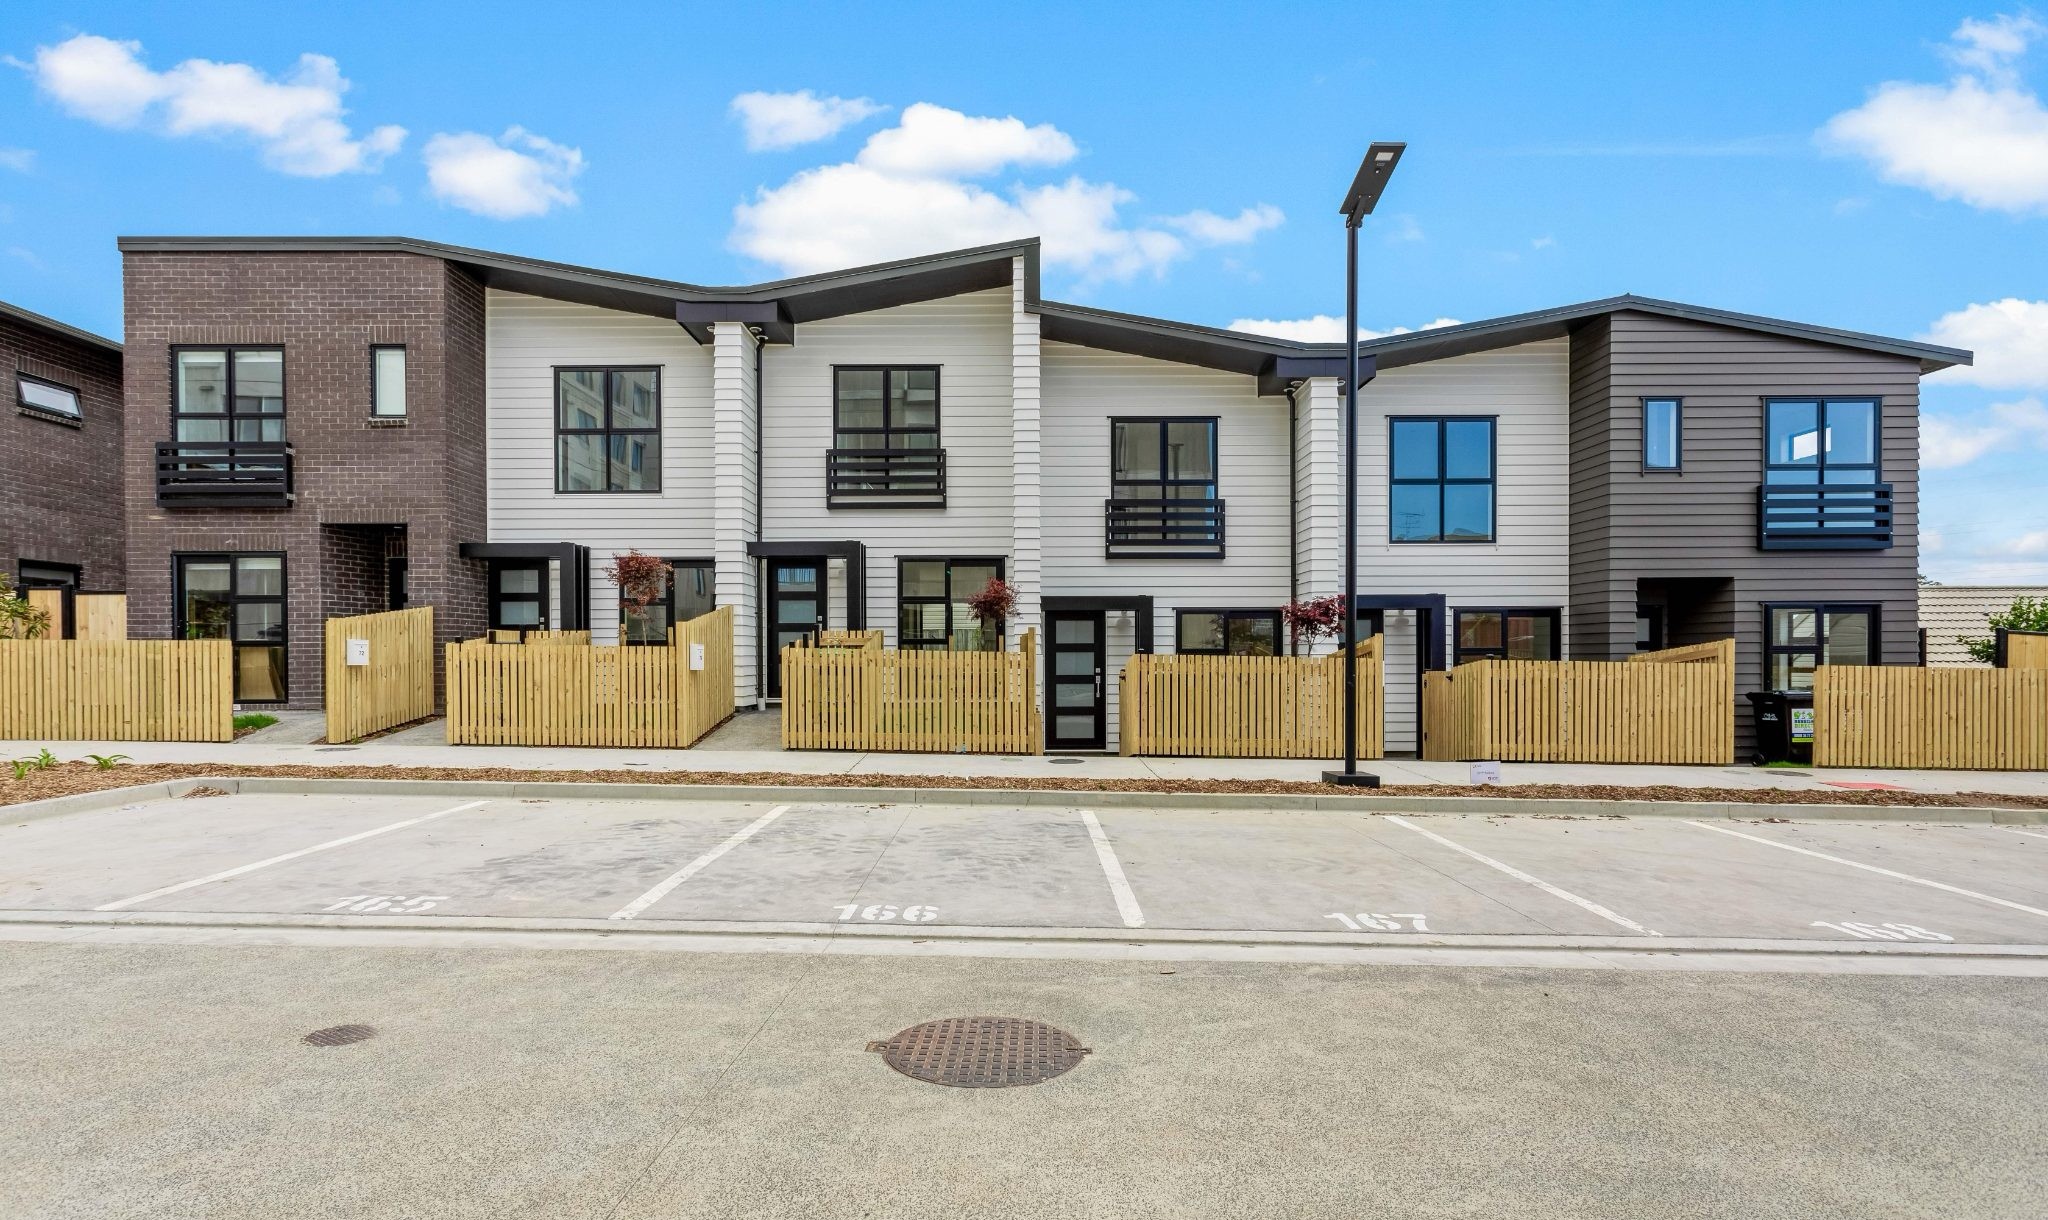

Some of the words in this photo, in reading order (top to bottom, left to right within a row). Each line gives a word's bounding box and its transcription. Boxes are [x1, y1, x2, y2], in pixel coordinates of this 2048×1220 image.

[321, 895, 451, 912] 165
[832, 904, 939, 922] 166
[1322, 912, 1430, 931] 167
[1809, 920, 1955, 941] 168
